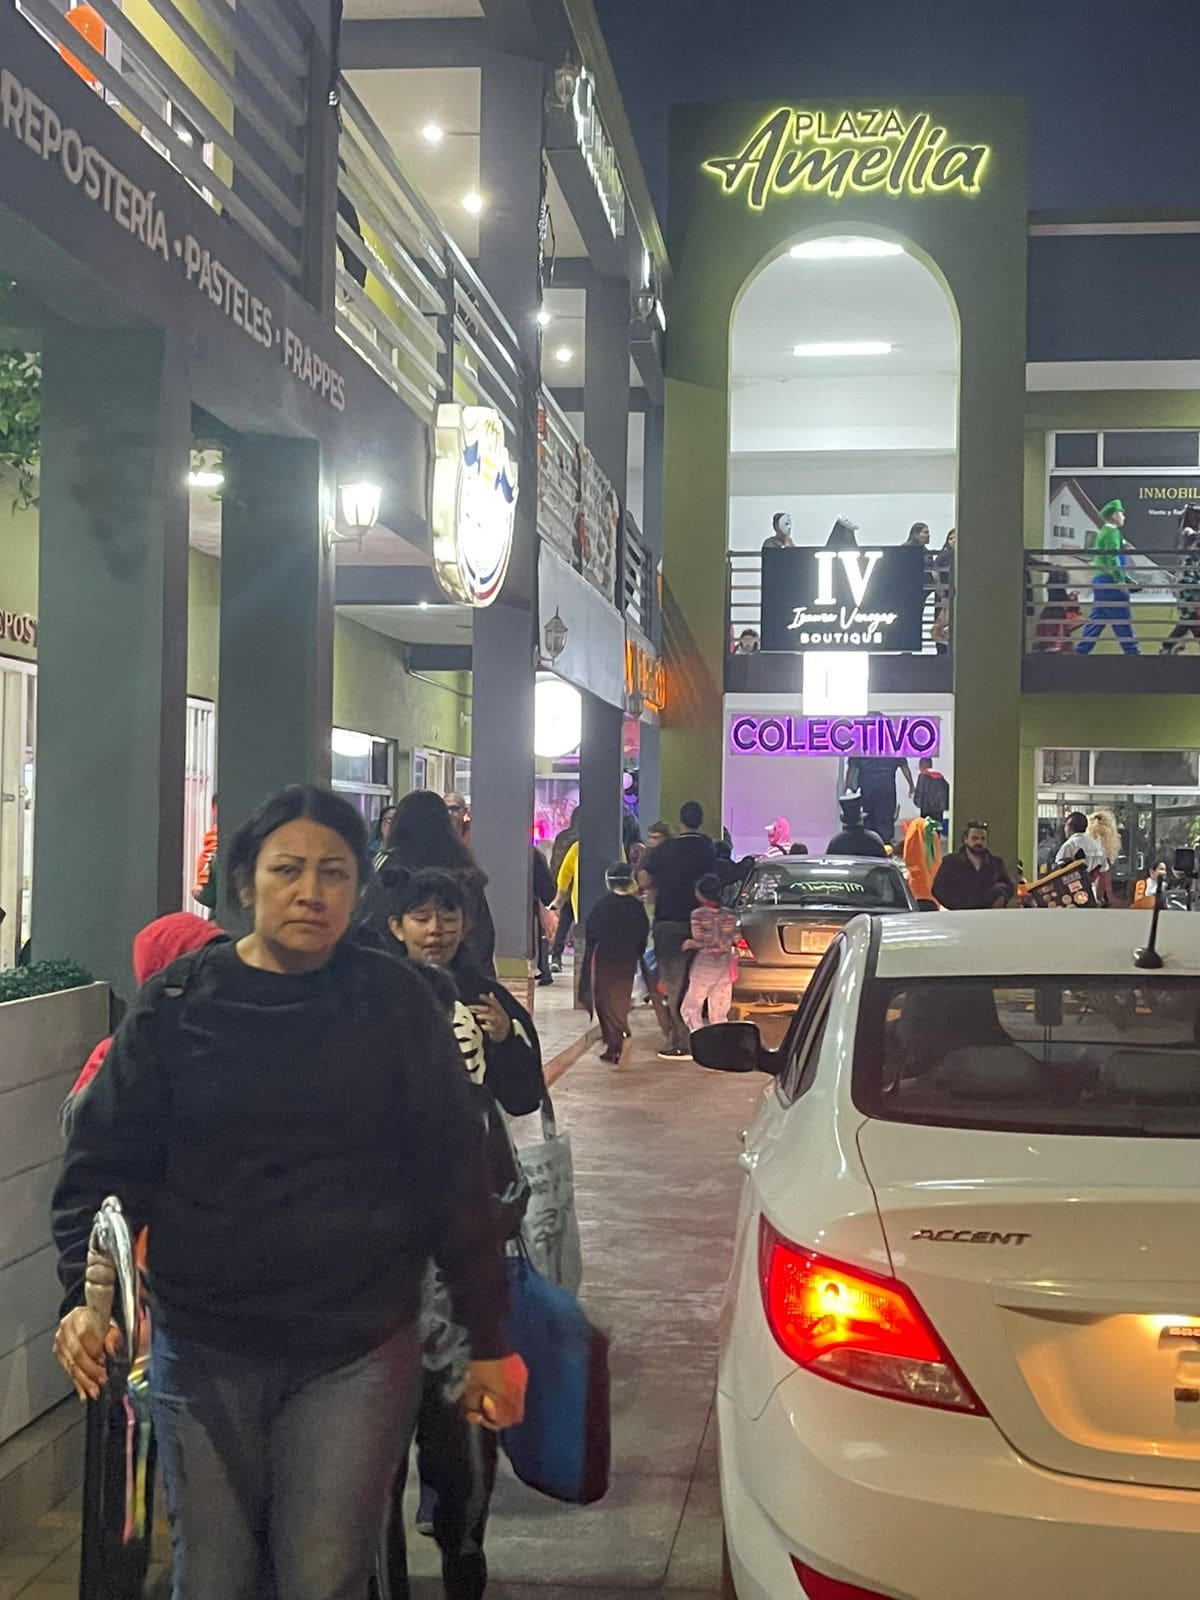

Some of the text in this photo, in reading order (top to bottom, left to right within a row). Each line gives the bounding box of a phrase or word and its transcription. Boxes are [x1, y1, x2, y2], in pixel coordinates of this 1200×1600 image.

[795, 109, 906, 140] PLAZA
[702, 107, 990, 209] Amelia
[1, 68, 346, 411] REPOSTERÍA PASTELES FRAPPES
[813, 550, 884, 608] IV
[0, 609, 37, 642] POS
[800, 632, 883, 645] BOUTIQUE
[731, 717, 938, 753] COLECTIVO
[911, 1229, 1031, 1246] ACCENT
